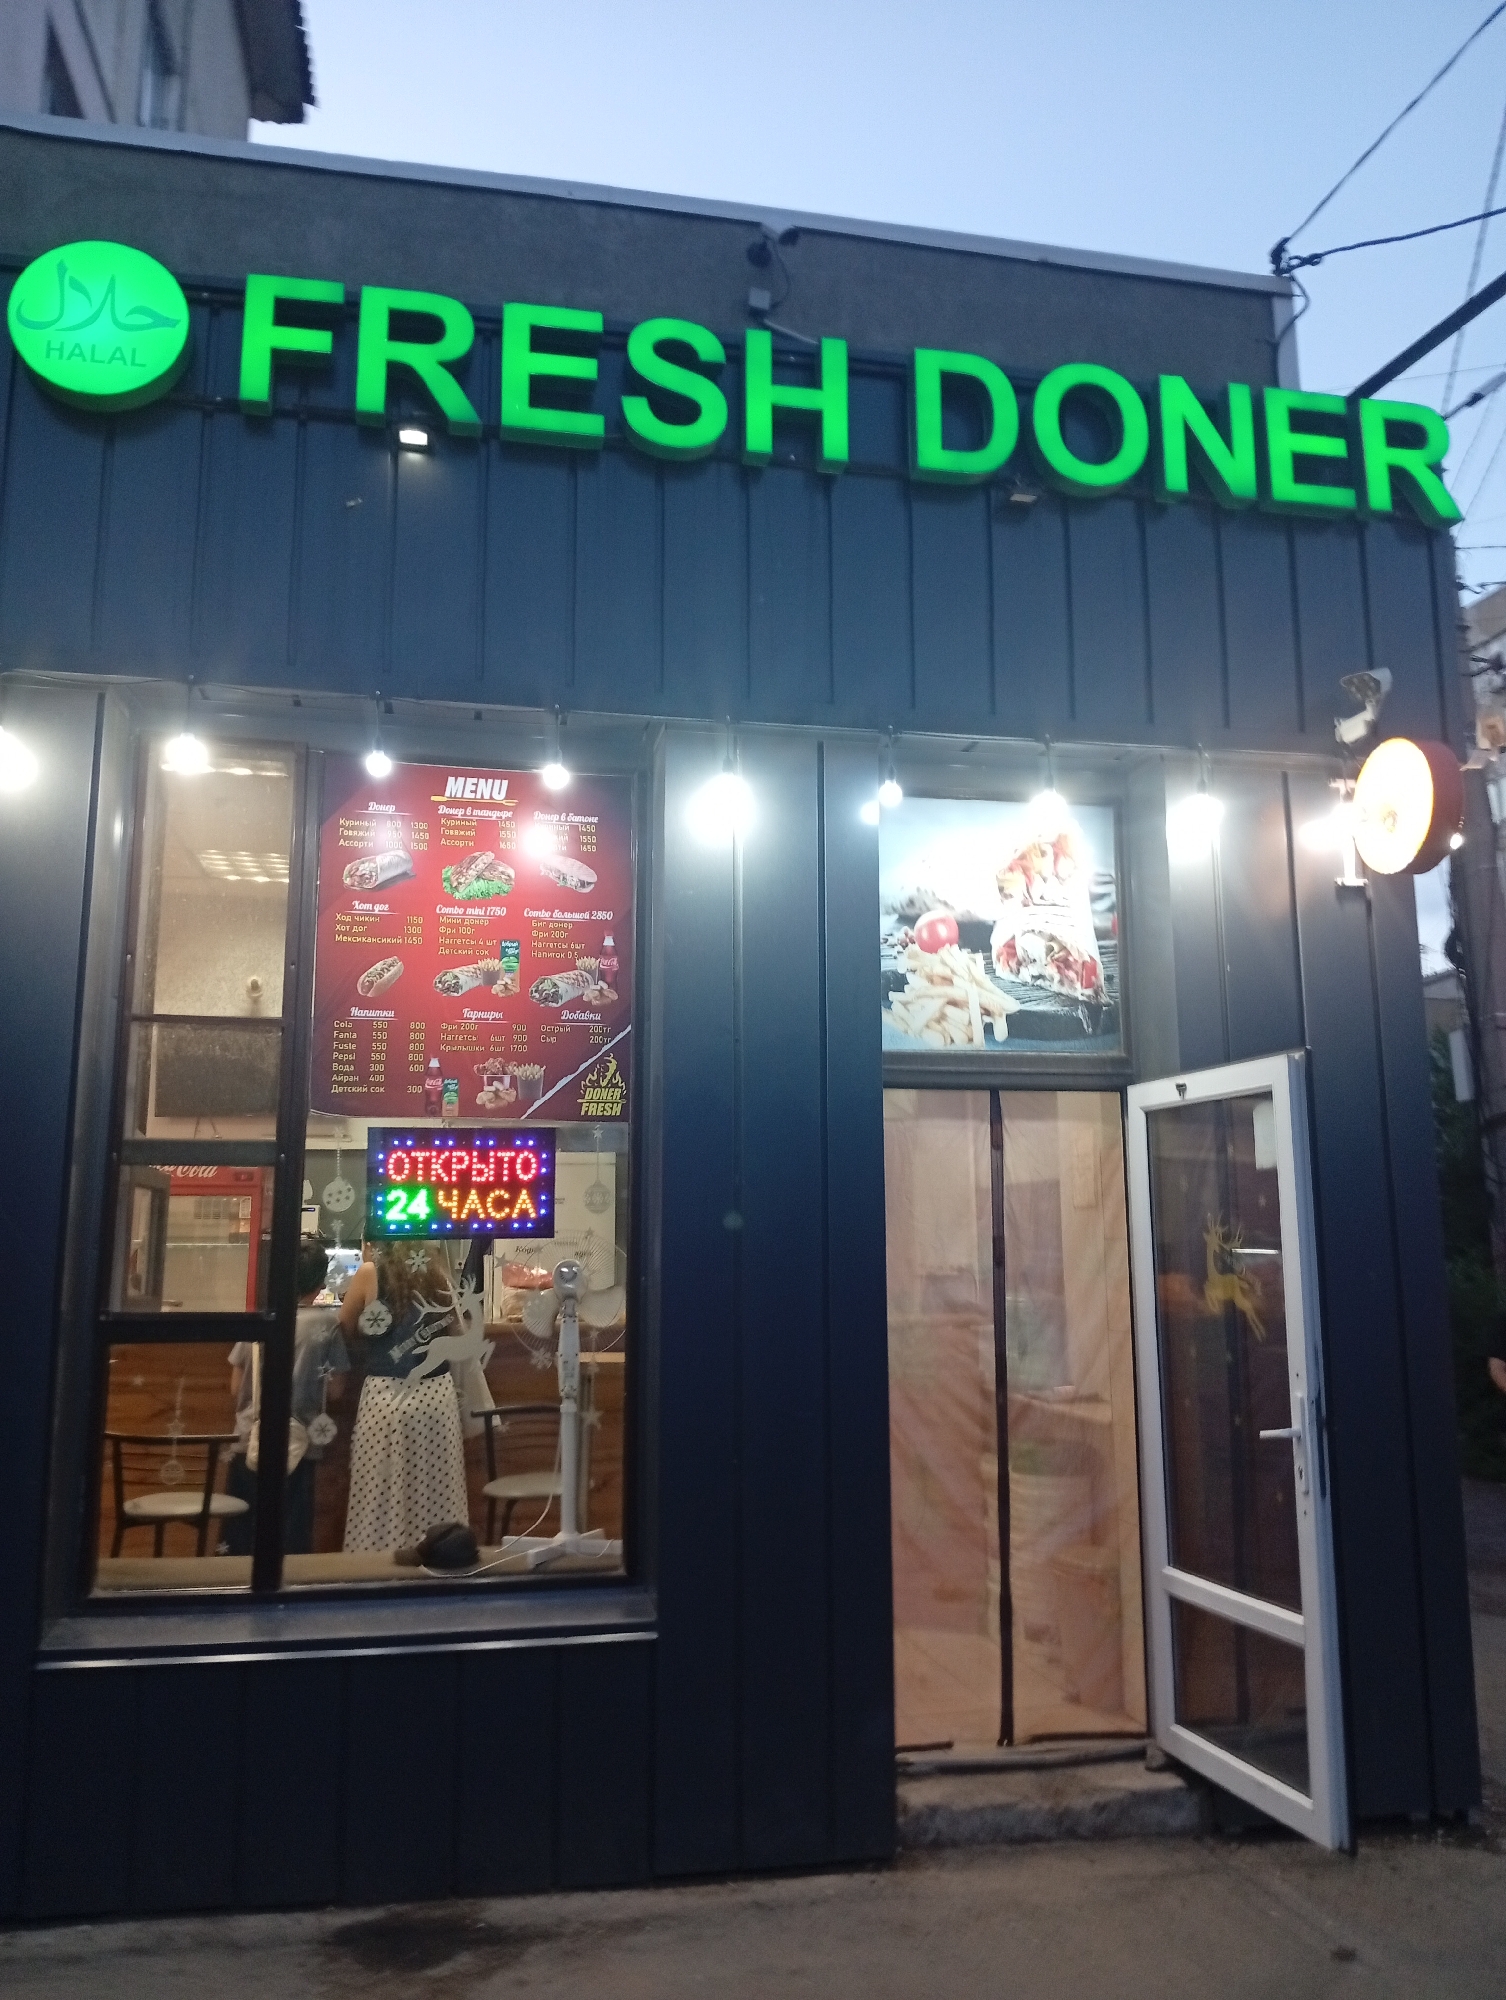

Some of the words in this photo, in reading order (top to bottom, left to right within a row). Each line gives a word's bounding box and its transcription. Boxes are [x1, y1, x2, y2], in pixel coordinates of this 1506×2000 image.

[16, 258, 182, 332] حلال
[45, 340, 147, 368] HALAL
[239, 273, 850, 470] FRESH
[914, 347, 1462, 524] DONER
[444, 776, 509, 800] MENU
[368, 801, 396, 813] Донер
[437, 804, 465, 817] Донер
[466, 806, 472, 815] в
[472, 808, 513, 819] тандыре
[533, 810, 559, 823] Донер
[561, 812, 567, 821] в
[567, 812, 599, 823] батоне
[339, 817, 377, 827] Куриный
[410, 821, 428, 829] 1300
[440, 817, 477, 827] Куриный
[497, 820, 516, 828] 1450
[440, 827, 476, 837] Говяжий
[499, 830, 517, 838] 1550
[578, 824, 596, 832] 1450
[339, 827, 376, 837] Говяжий
[411, 831, 430, 840] 1450
[338, 838, 374, 848] Ассорти
[385, 841, 403, 849] 1000
[410, 841, 428, 850] 1500
[440, 838, 475, 848] Ассорти
[580, 835, 597, 843] 1550
[580, 844, 597, 852] 1650
[352, 900, 373, 910] Хот
[374, 903, 389, 913] дог
[435, 904, 465, 915] Combo
[465, 906, 485, 915] mini
[486, 906, 507, 917] 1750
[335, 913, 352, 922] Ход
[406, 916, 423, 924] 1150
[523, 907, 552, 918] Combo
[552, 909, 590, 919] большой
[590, 910, 614, 920] 2850
[439, 916, 462, 924] Мини
[531, 919, 547, 927] Биг
[335, 923, 350, 931] Хот
[352, 925, 367, 933] дог
[403, 925, 422, 934] 1300
[438, 926, 456, 935] Фри
[458, 926, 475, 934] 100г
[531, 929, 549, 939] Фри
[551, 930, 569, 938] 200г
[404, 936, 423, 945] 1450
[438, 936, 477, 945] Наггетсы
[531, 940, 568, 949] Наггетсы
[438, 946, 473, 955] Детский
[531, 950, 565, 959] Напиток
[350, 1006, 395, 1018] Напитки
[462, 1008, 504, 1021] Гарниры
[560, 1009, 601, 1020] Добавки
[333, 1020, 353, 1028] Cola
[372, 1021, 388, 1029] 550
[440, 1022, 458, 1031] Фри
[460, 1023, 479, 1031] 200г
[540, 1024, 571, 1033] Острый
[333, 1030, 357, 1039] Fanta
[372, 1031, 388, 1039] 550
[409, 1032, 425, 1040] 800
[440, 1033, 478, 1041] Наггетсы
[512, 1034, 528, 1042] 900
[540, 1035, 557, 1044] Сыр
[371, 1042, 387, 1050] 550
[409, 1043, 425, 1051] 800
[332, 1052, 356, 1061] Pepsi
[370, 1052, 386, 1061] 550
[408, 1053, 424, 1061] 800
[332, 1062, 355, 1072] Вода
[369, 1063, 385, 1072] 300
[409, 1064, 425, 1072] 600
[331, 1073, 359, 1083] Айран
[369, 1074, 385, 1082] 400
[331, 1084, 368, 1094] Детский
[407, 1085, 423, 1093] 300
[584, 1087, 622, 1100] DONER
[580, 1102, 622, 1116] FRESH
[387, 1150, 539, 1182] ОТКРЫТО
[385, 1188, 431, 1221] 24
[437, 1188, 538, 1220] ЧАСА
